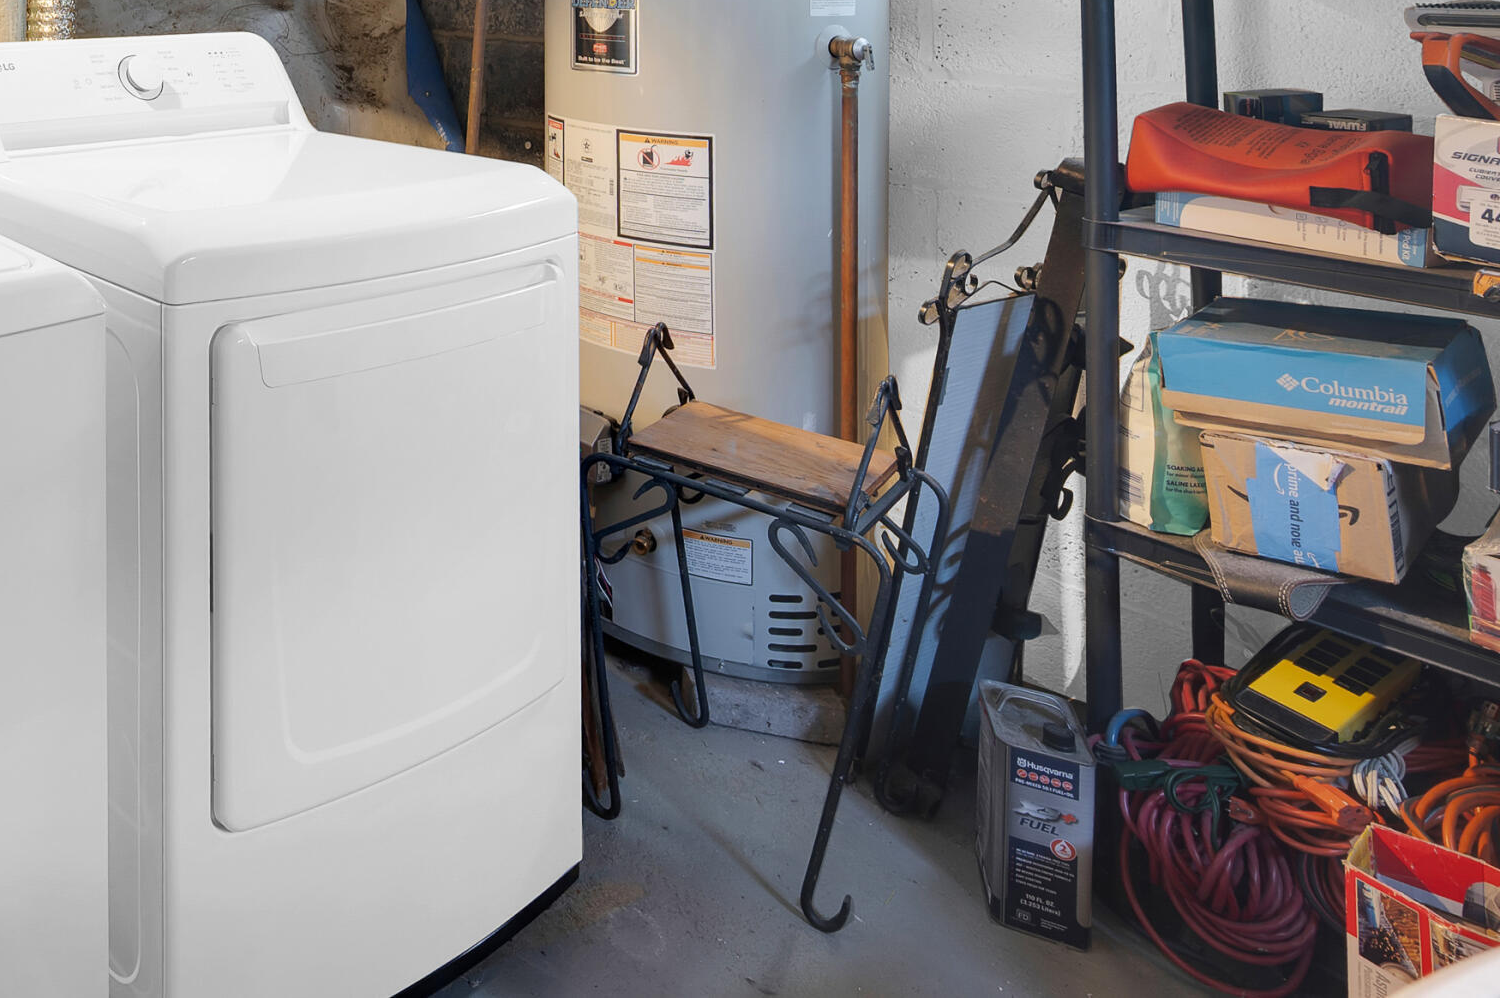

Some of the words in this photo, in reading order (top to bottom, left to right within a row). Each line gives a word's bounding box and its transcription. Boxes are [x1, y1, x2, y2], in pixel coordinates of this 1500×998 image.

[3, 63, 15, 71] LG
[1327, 120, 1367, 131] FLUVAL
[1301, 376, 1408, 405] Columbia
[1328, 397, 1409, 416] montrail
[1167, 464, 1196, 472] SOAKING
[1284, 463, 1301, 498] prime
[1290, 500, 1304, 523] and
[1027, 760, 1074, 780] Husqvarna
[1020, 818, 1060, 836] FUEL
